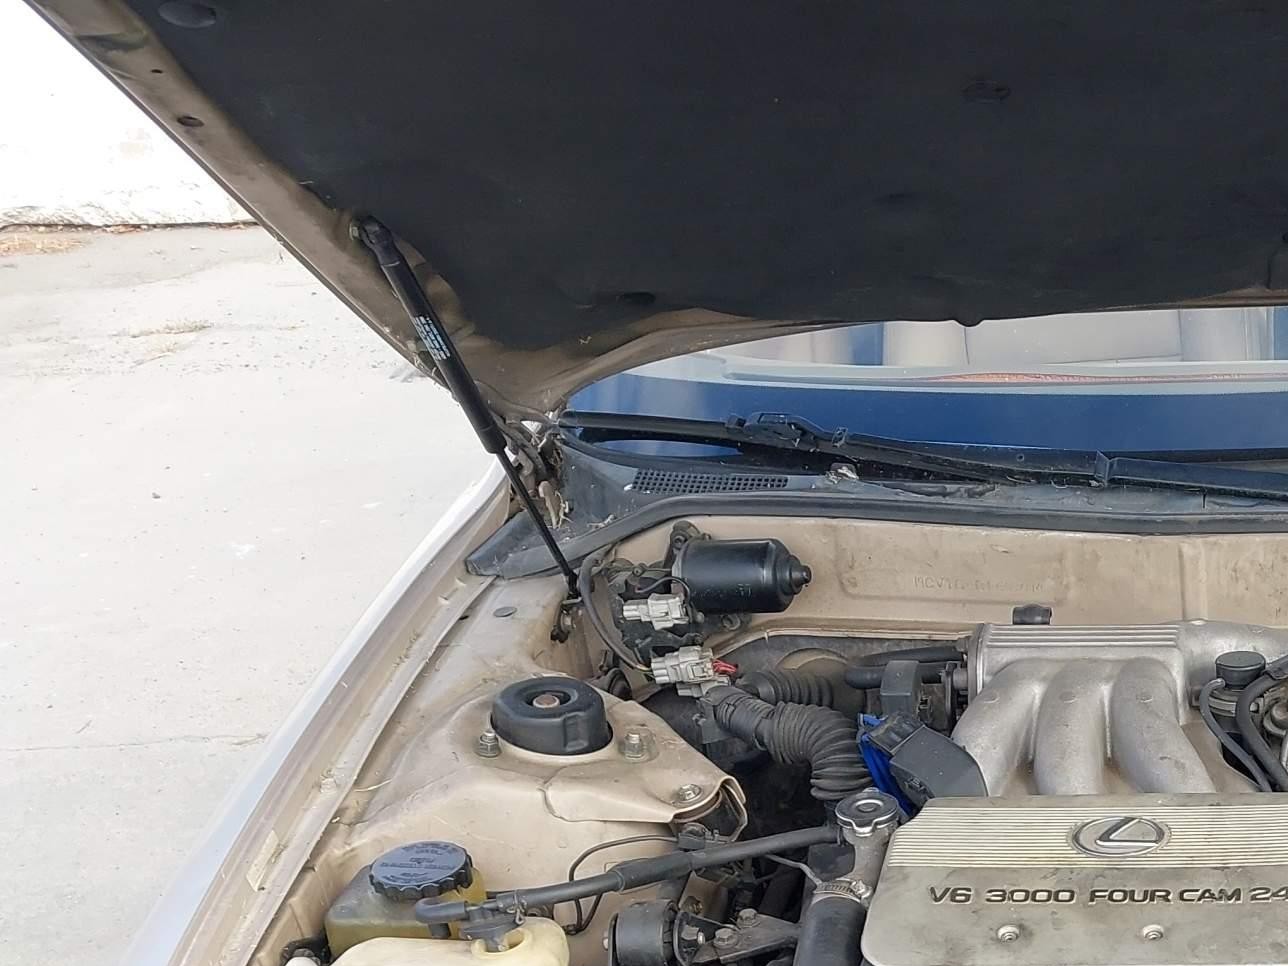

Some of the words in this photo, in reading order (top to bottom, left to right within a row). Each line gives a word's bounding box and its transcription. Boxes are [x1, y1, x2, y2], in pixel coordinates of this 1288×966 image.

[928, 886, 973, 904] V6
[984, 887, 1077, 904] 3000
[1087, 887, 1173, 904] FOUR
[1178, 887, 1243, 904] CAM
